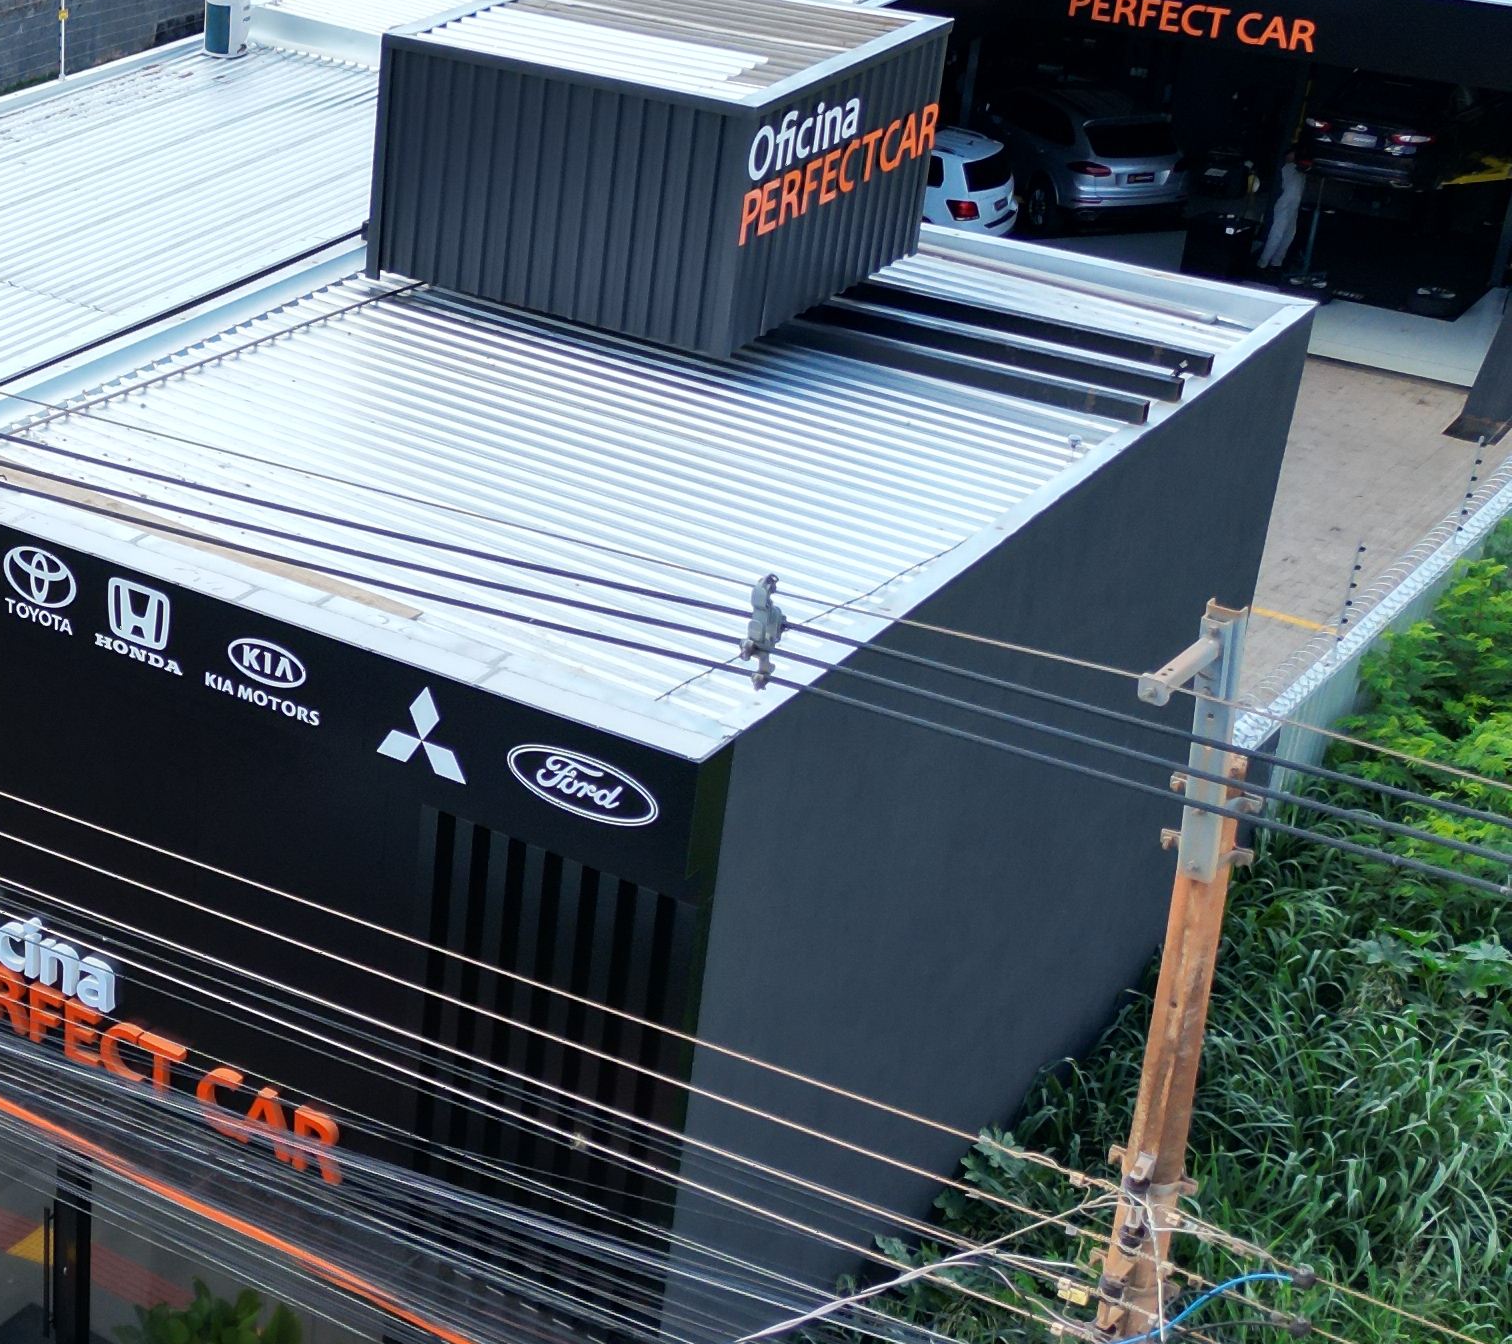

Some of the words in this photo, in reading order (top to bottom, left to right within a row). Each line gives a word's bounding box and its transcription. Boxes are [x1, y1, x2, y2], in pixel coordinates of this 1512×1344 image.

[1236, 12, 1316, 53] CAR
[748, 97, 861, 181] Oficina
[4, 597, 74, 636] TOYOTA
[94, 632, 184, 676] HONDA
[240, 643, 294, 682] KIA
[204, 671, 235, 696] KIA
[236, 683, 320, 726] MOTORS
[535, 754, 624, 809] Ford
[196, 1067, 343, 1186] CAR
